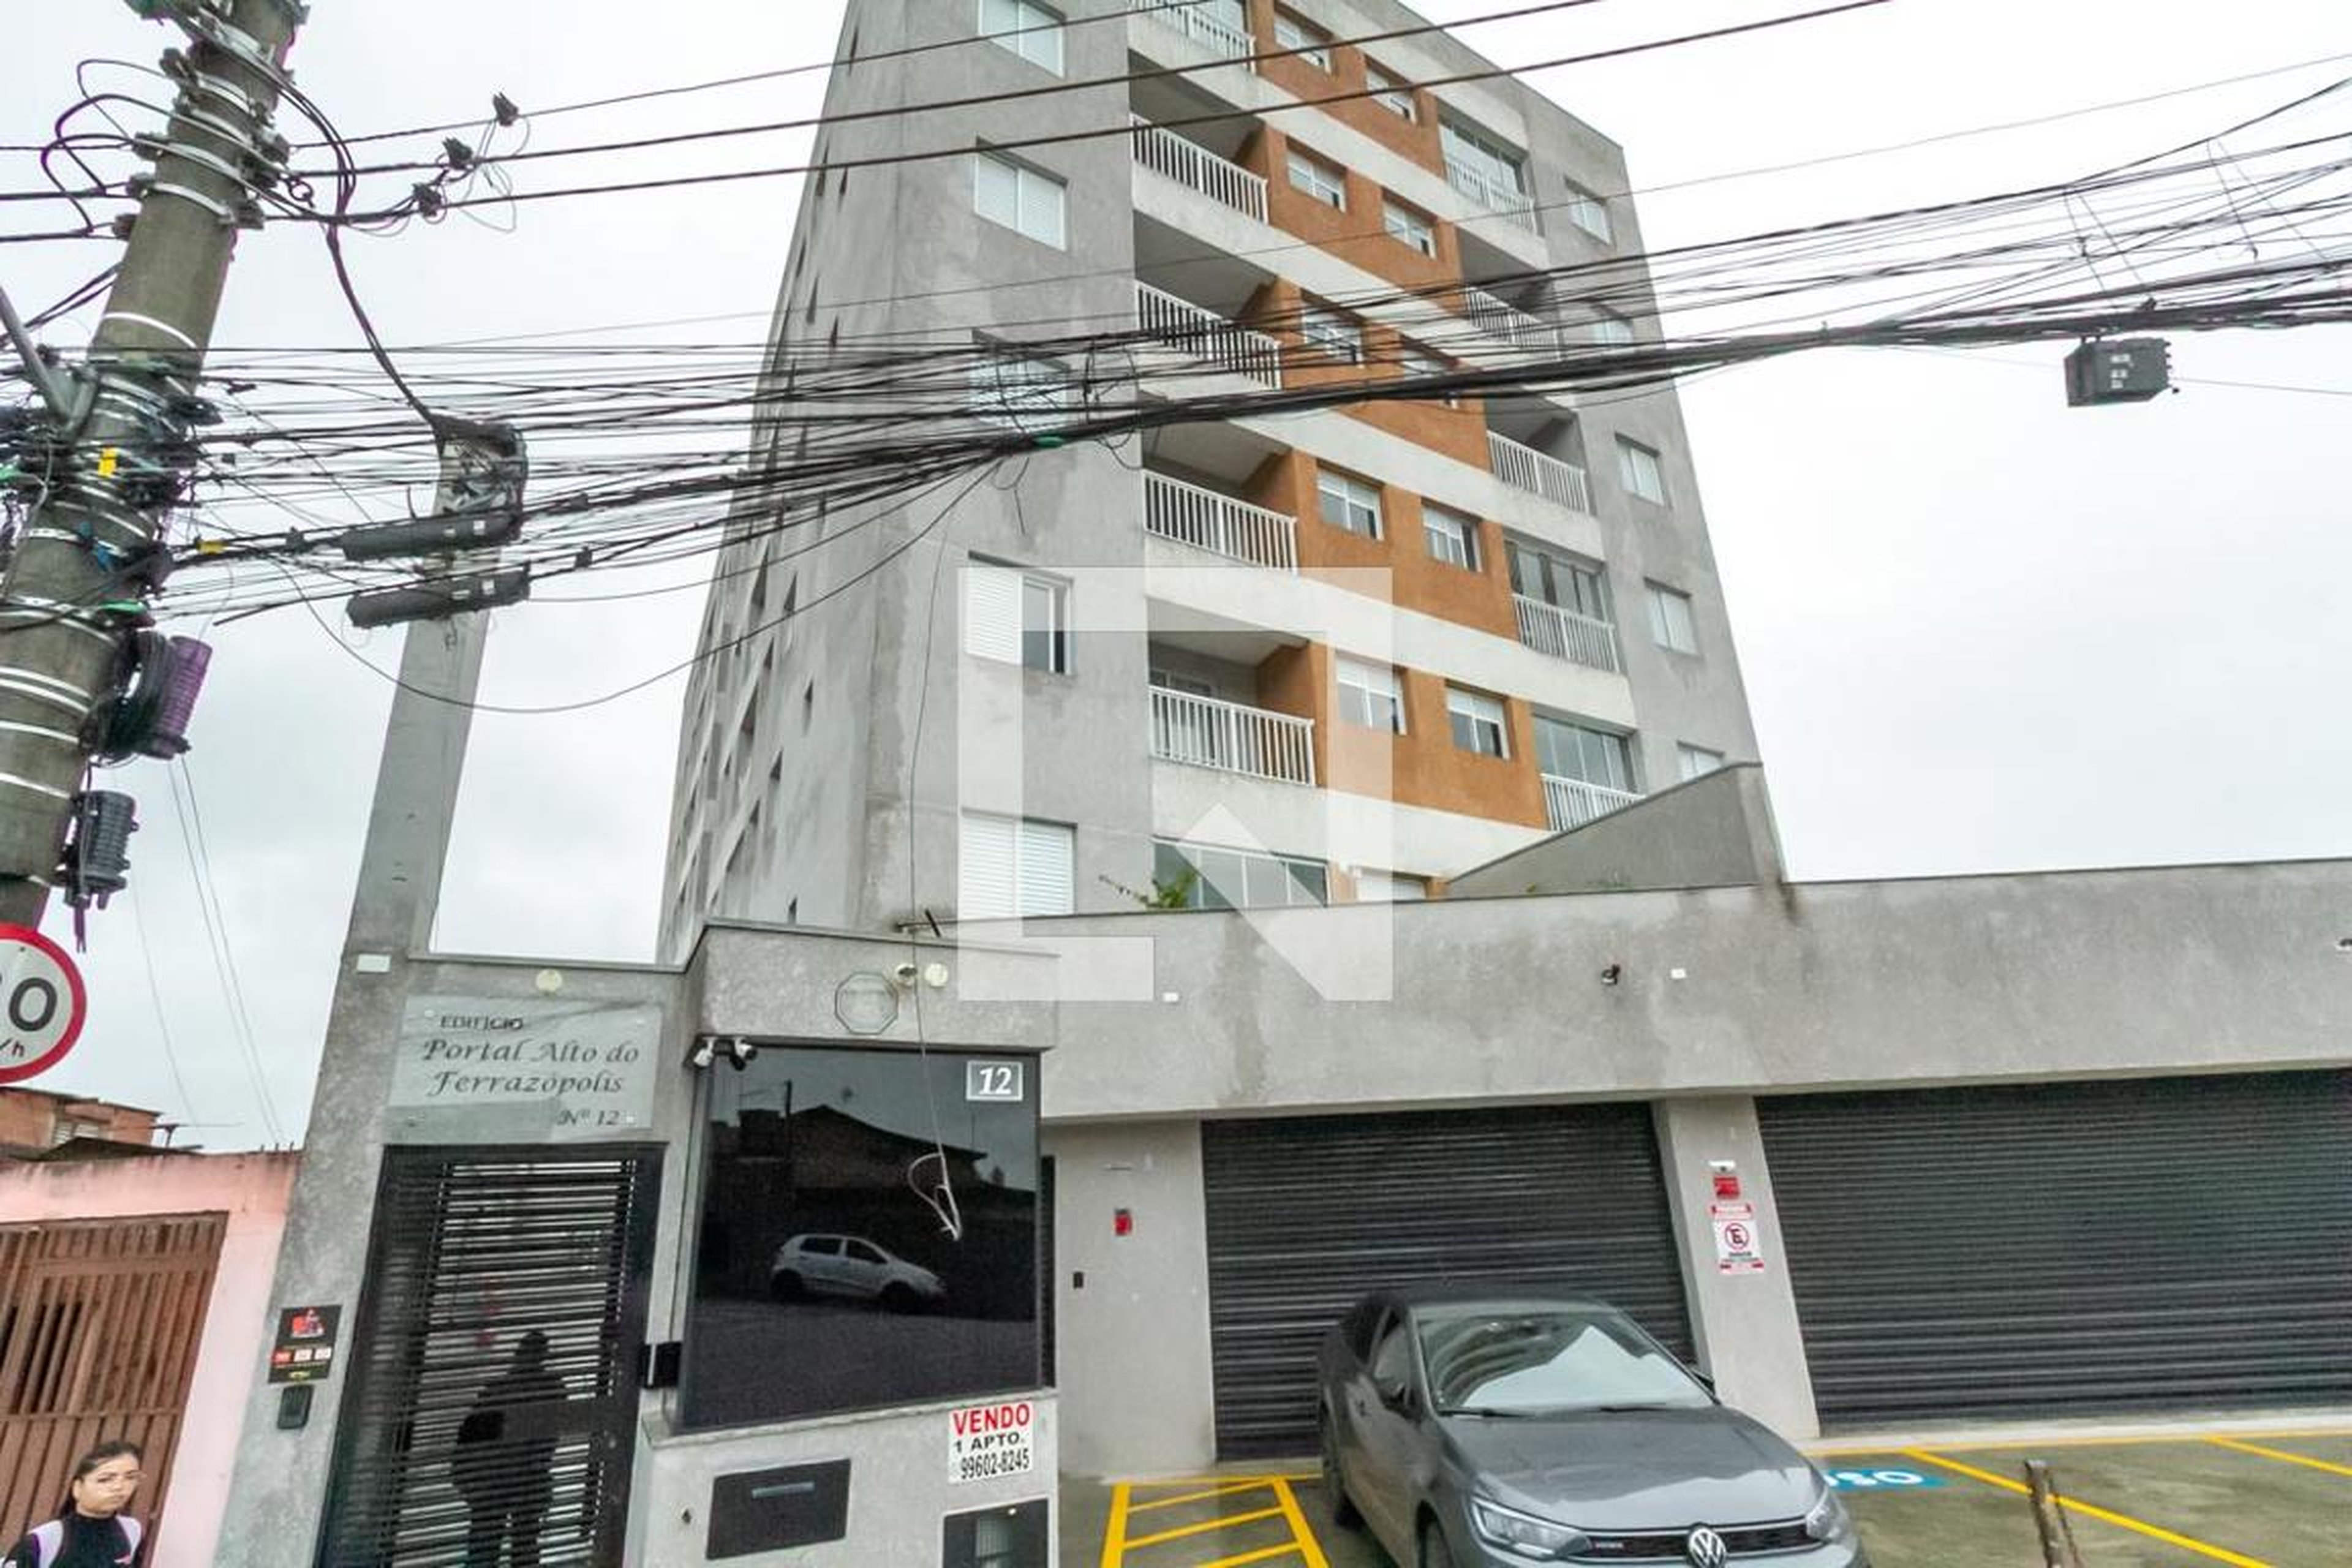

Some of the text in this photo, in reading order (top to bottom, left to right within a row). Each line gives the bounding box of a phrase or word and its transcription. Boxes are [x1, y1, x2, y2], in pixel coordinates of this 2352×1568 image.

[0, 973, 58, 1031] 0
[423, 1038, 639, 1064] Portal Alto do
[979, 1066, 1011, 1095] 12
[597, 1109, 620, 1126] 12
[952, 1404, 1030, 1436] VENDO
[954, 1439, 962, 1453] 1
